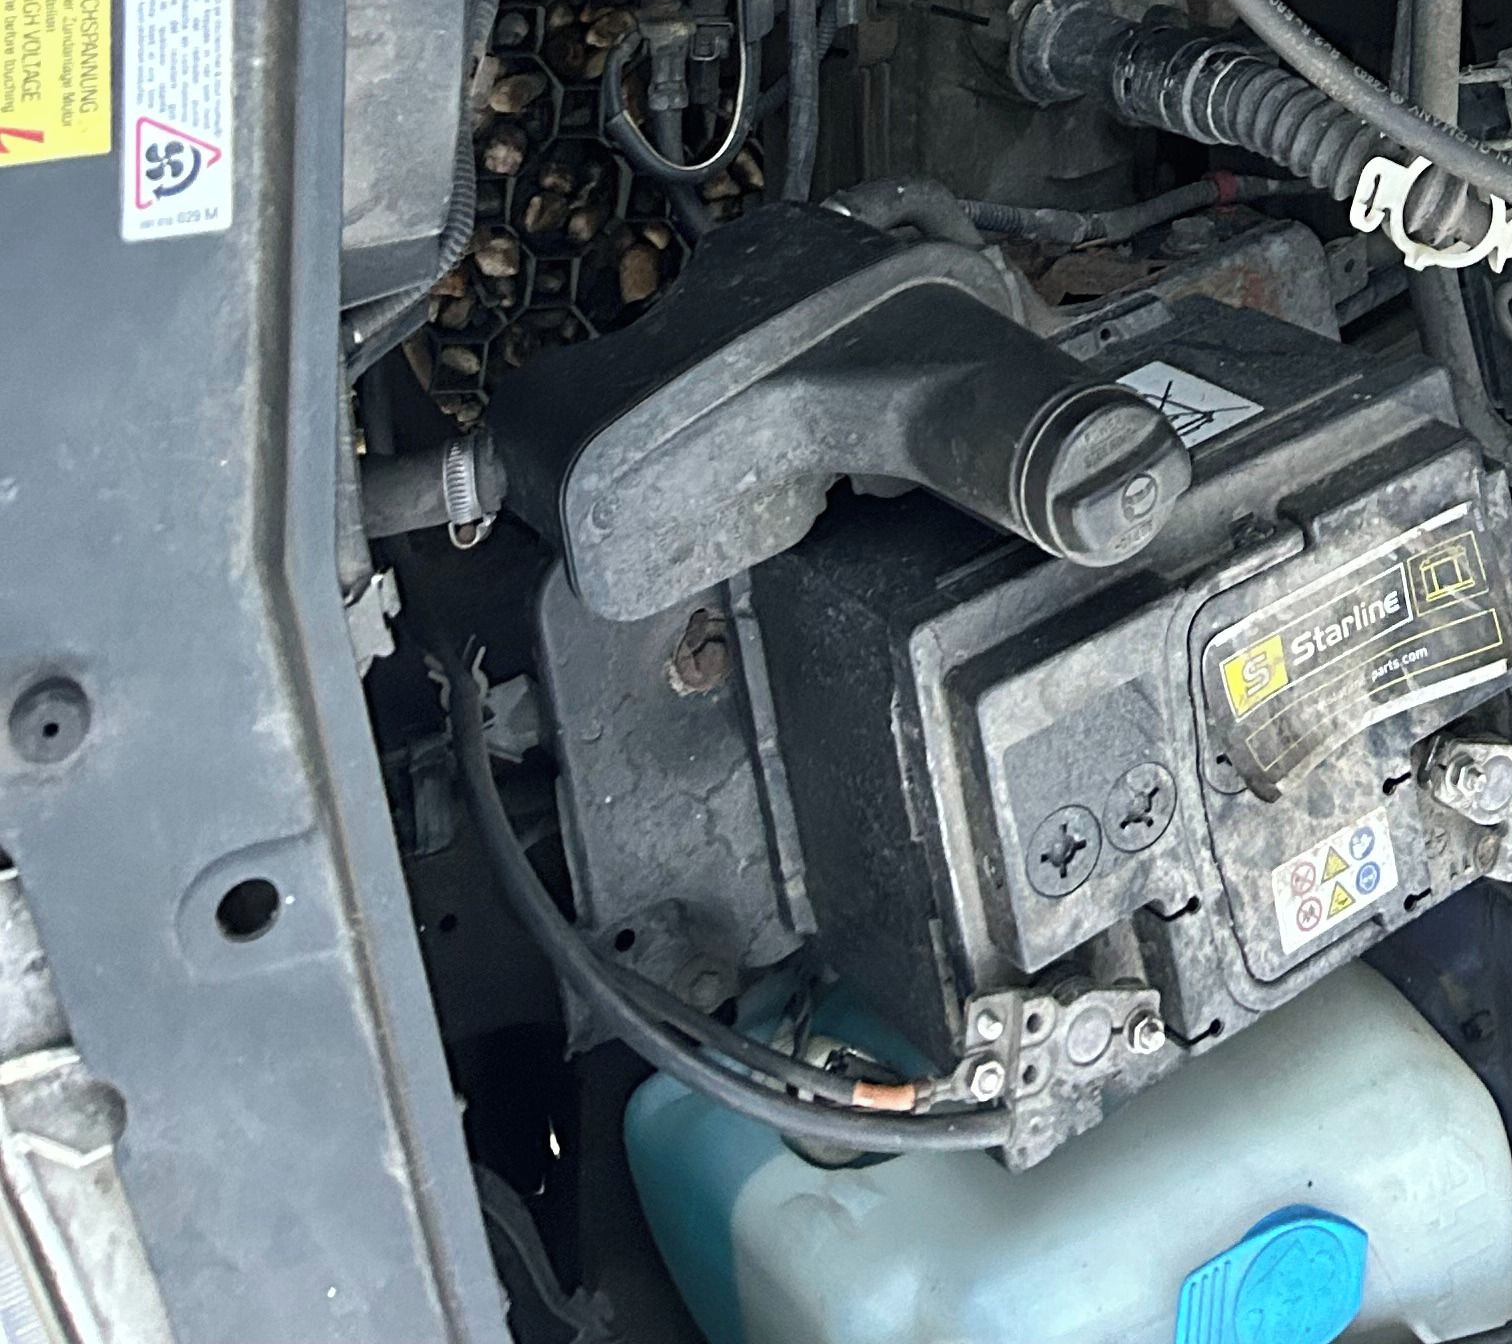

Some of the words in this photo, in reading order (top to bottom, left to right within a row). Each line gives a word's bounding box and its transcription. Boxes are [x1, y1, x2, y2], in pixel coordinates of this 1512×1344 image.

[0, 59, 16, 113] touching
[21, 31, 41, 102] VOLTAGE
[1290, 589, 1402, 666] Starline
